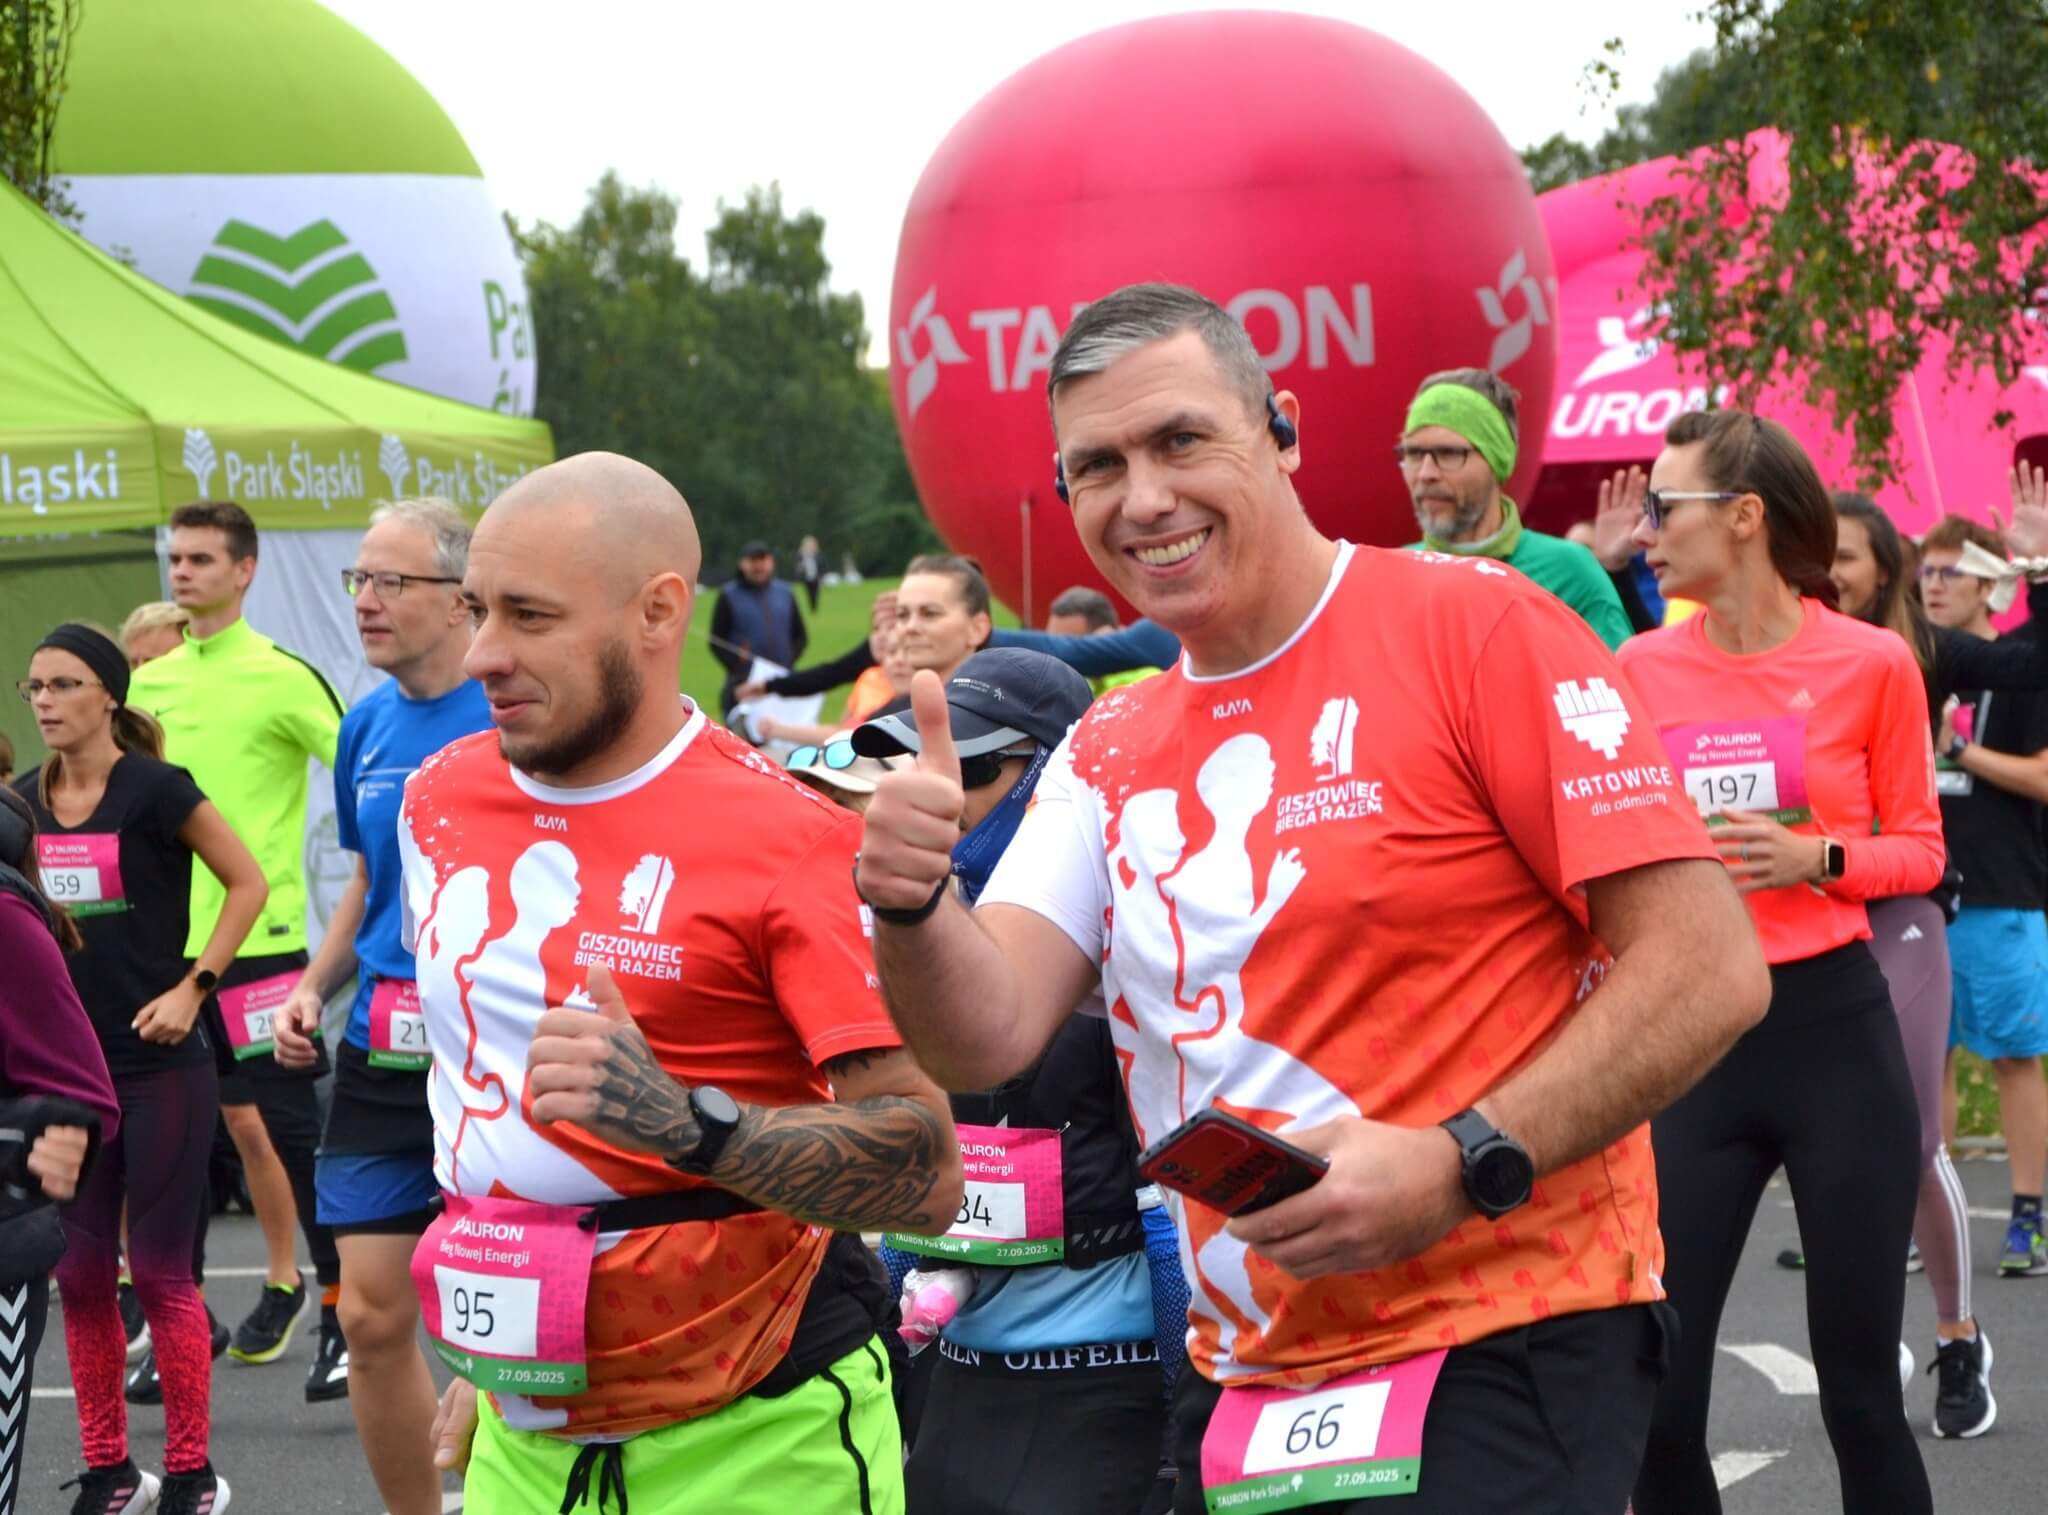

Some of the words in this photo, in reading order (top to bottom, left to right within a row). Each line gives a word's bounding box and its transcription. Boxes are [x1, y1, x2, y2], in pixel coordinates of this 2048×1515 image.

[969, 282, 1375, 391] TAON
[224, 450, 287, 499] Park
[288, 439, 365, 511] Śląski
[416, 457, 472, 503] Park
[1712, 732, 1762, 747] TAURON
[1277, 780, 1383, 817] GISZOWIEC
[1561, 766, 1673, 800] KATOWICE
[1702, 773, 1757, 805] 197
[1275, 809, 1317, 834] BIEGA
[1321, 799, 1383, 822] RAZEM
[54, 874, 80, 895] 59
[578, 932, 684, 965] GISZOWIEC
[620, 958, 682, 981] RAZEM
[979, 1162, 1014, 1177] Energii
[485, 1247, 530, 1269] Energii
[996, 1244, 1048, 1257] 27.09.2025
[453, 1287, 495, 1338] 95
[497, 1368, 566, 1385] 27.09.2025
[1285, 1403, 1345, 1455] 66
[1334, 1467, 1399, 1488] 27.09.2025
